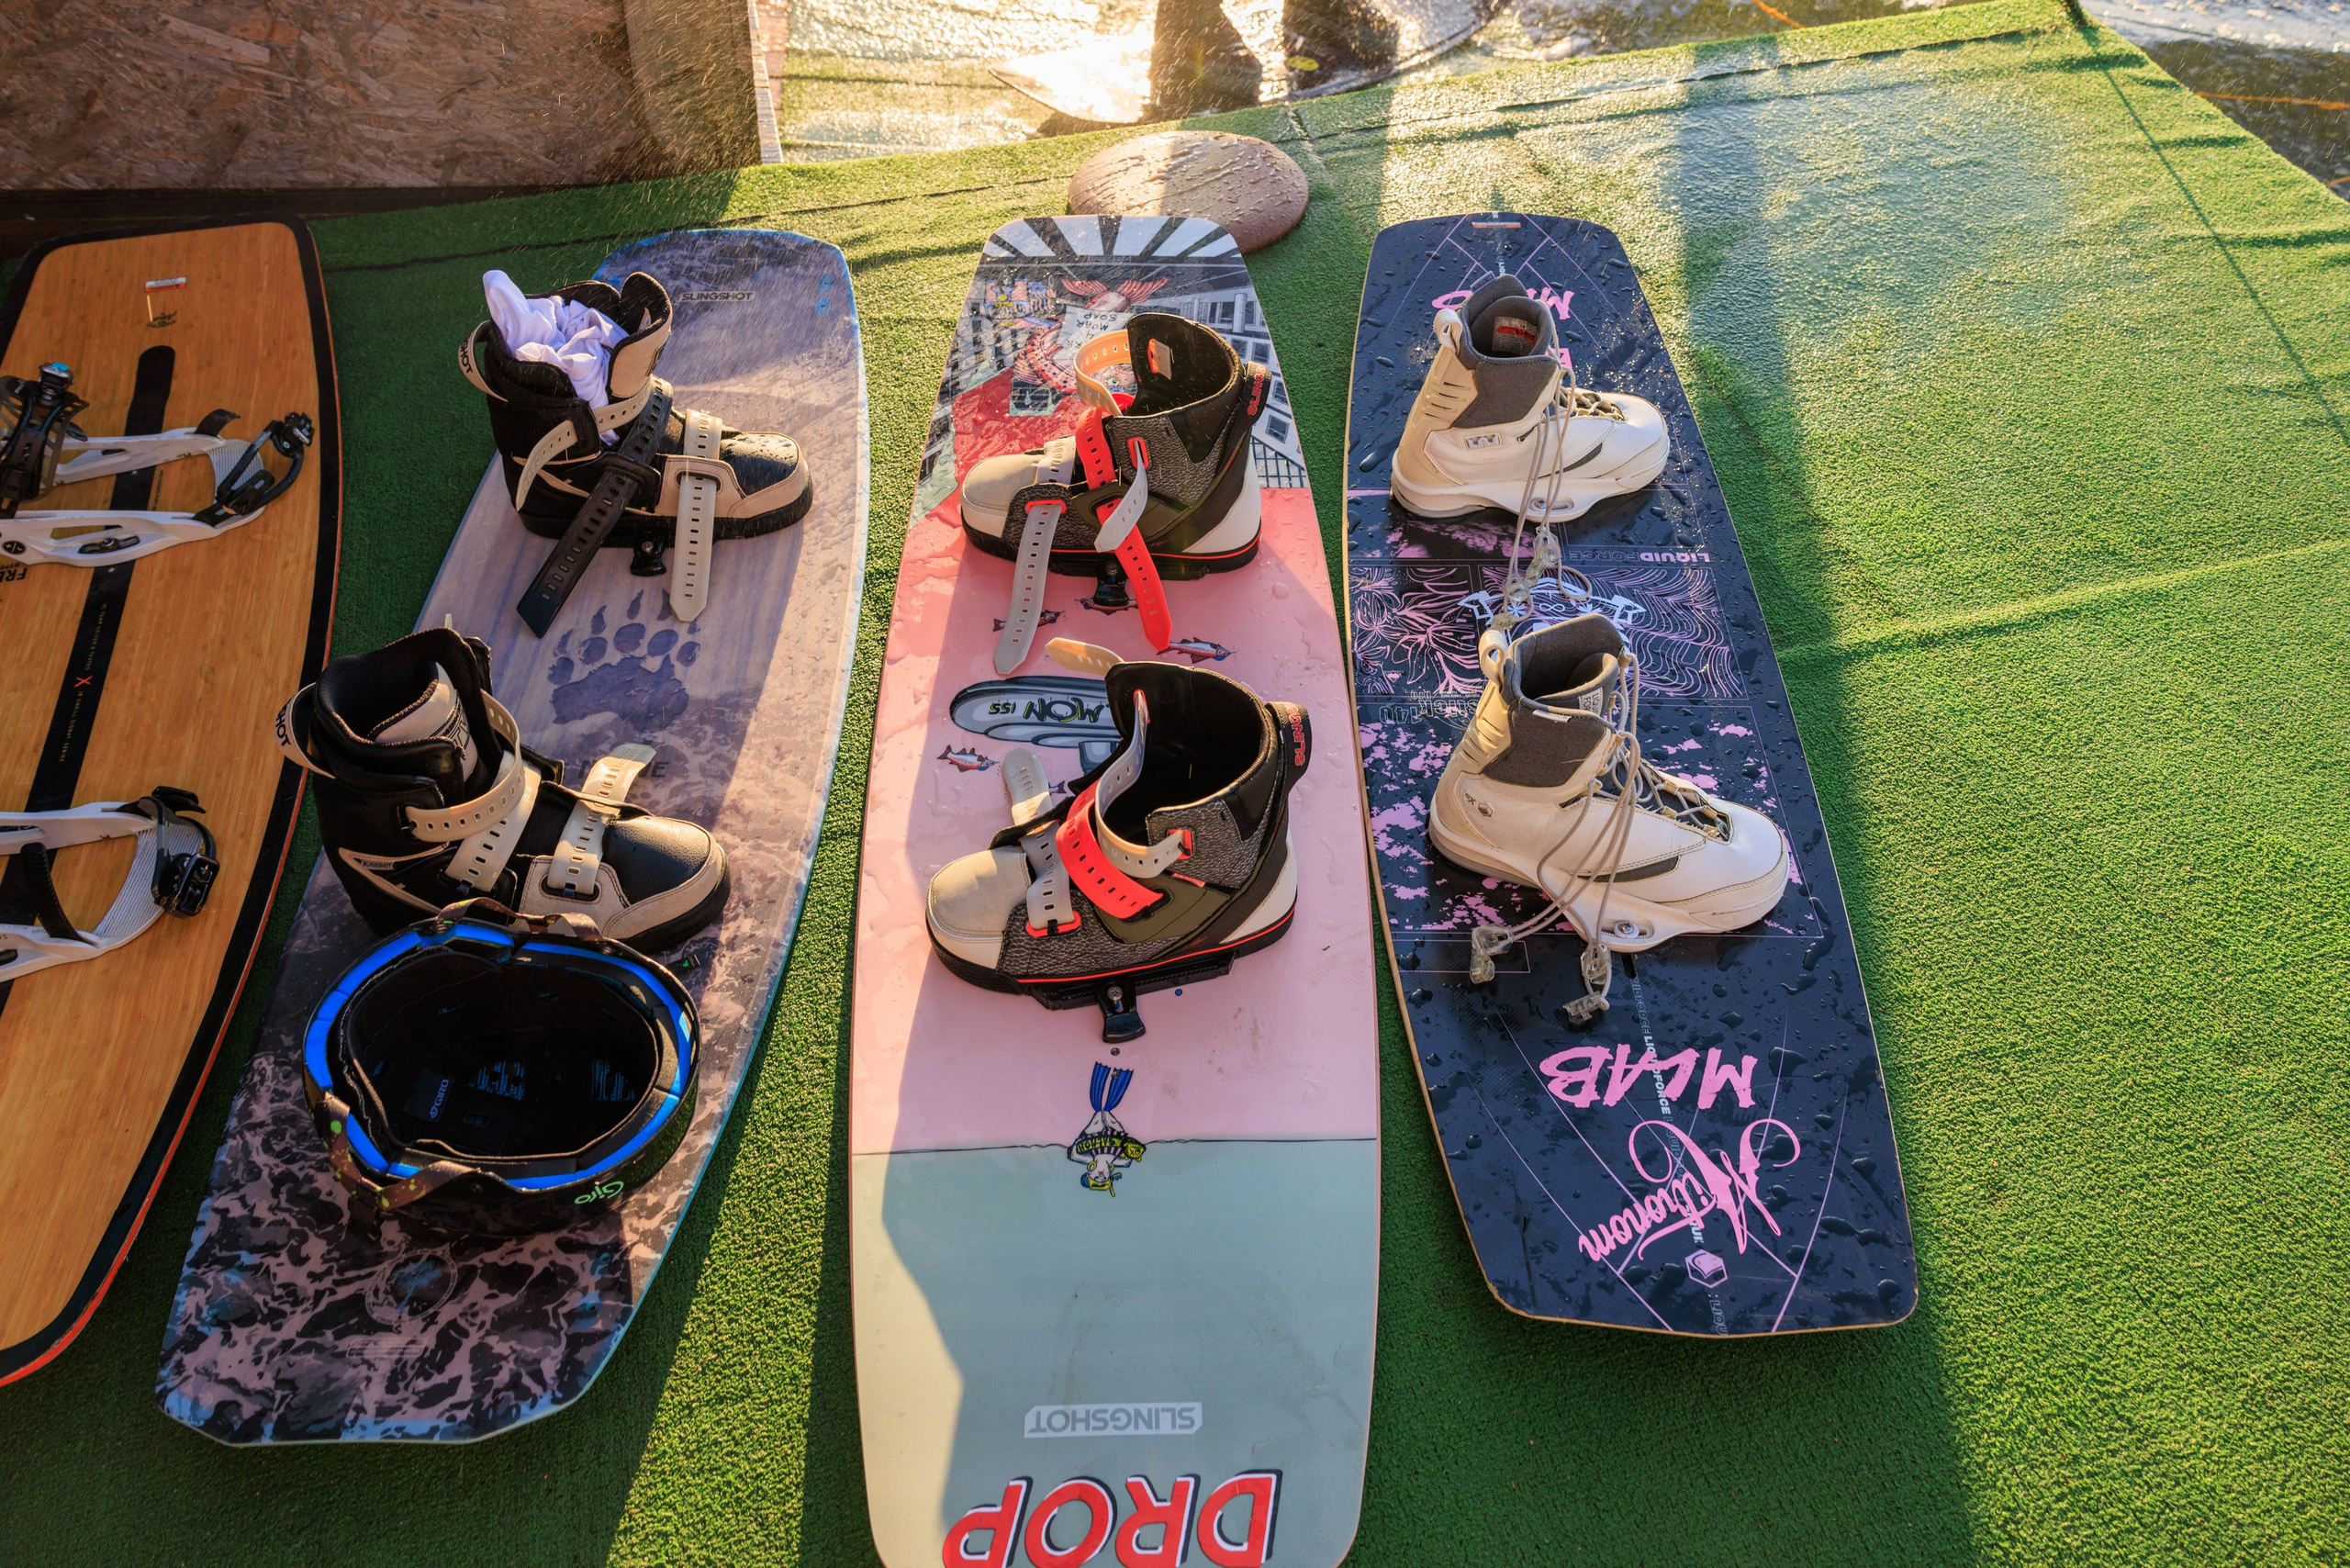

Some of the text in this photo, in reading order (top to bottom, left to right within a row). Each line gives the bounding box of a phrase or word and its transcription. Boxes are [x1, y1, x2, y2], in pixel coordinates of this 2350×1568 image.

[682, 292, 753, 301] SLINGSHOT
[1077, 319, 1110, 330] MOAR
[1084, 312, 1117, 322] SOAP
[1539, 1043, 1758, 1110] MLAB
[433, 1079, 450, 1107] GIRO
[575, 1181, 624, 1204] Giro
[1029, 1406, 1197, 1434] SLINGSHOT
[942, 1469, 1283, 1568] DROP
